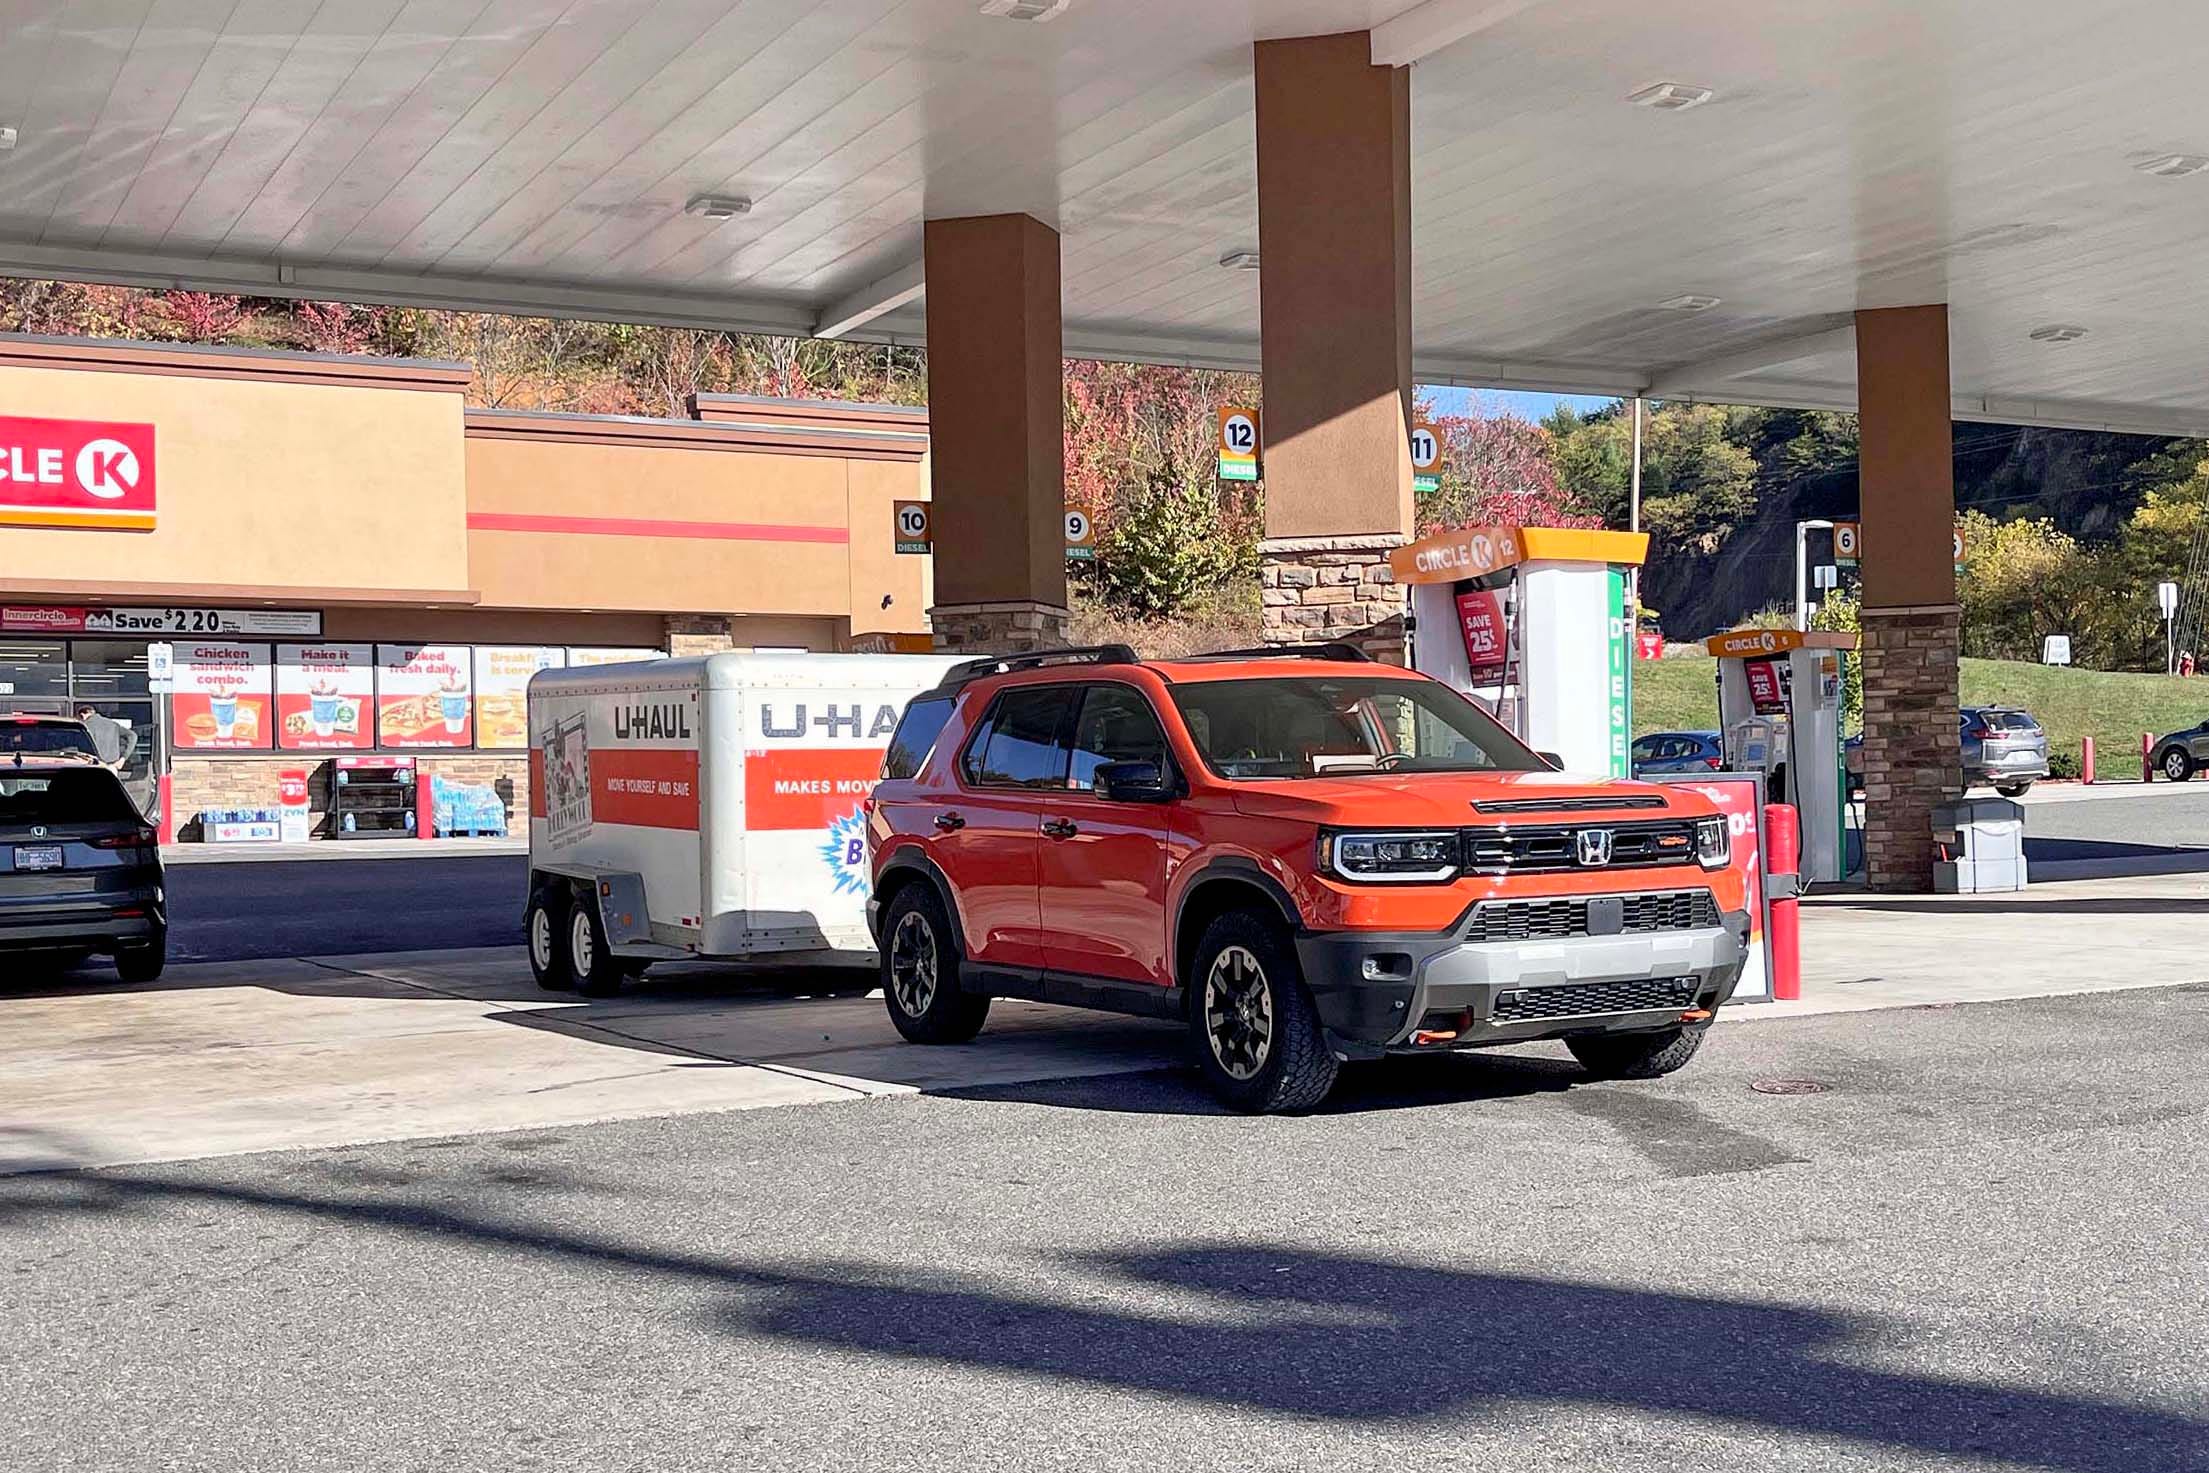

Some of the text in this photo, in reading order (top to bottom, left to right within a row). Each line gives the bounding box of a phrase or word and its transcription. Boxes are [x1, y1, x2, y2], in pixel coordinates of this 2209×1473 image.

[1229, 423, 1251, 447] 12
[1412, 437, 1431, 460] 11
[85, 444, 136, 497] K
[1223, 462, 1257, 476] DIESEL
[901, 513, 925, 530] 10
[1069, 517, 1081, 534] 9
[896, 543, 928, 553] DIESEL
[1841, 533, 1850, 548] 6
[1066, 547, 1090, 556] IESEL
[1415, 536, 1514, 573] CIRCLE K 12
[115, 614, 163, 628] Save
[165, 608, 219, 632] $2.20
[1466, 614, 1491, 629] SAVE
[1470, 628, 1495, 653] 25¢
[1724, 637, 1760, 651] CIRCLE
[1761, 632, 1776, 651] K
[194, 648, 249, 659] Chicken
[301, 649, 349, 660] Make it
[404, 651, 445, 661] Baked
[190, 660, 254, 672] sandwich
[302, 662, 349, 673] a meal.
[389, 663, 461, 677] fresh daily.
[196, 673, 249, 685] combo.
[615, 704, 690, 739] U-HAUL
[761, 703, 898, 738] U-HA
[607, 778, 690, 796] MOVE YOURSELF AND SAVE
[775, 779, 874, 794] MAKES MOV
